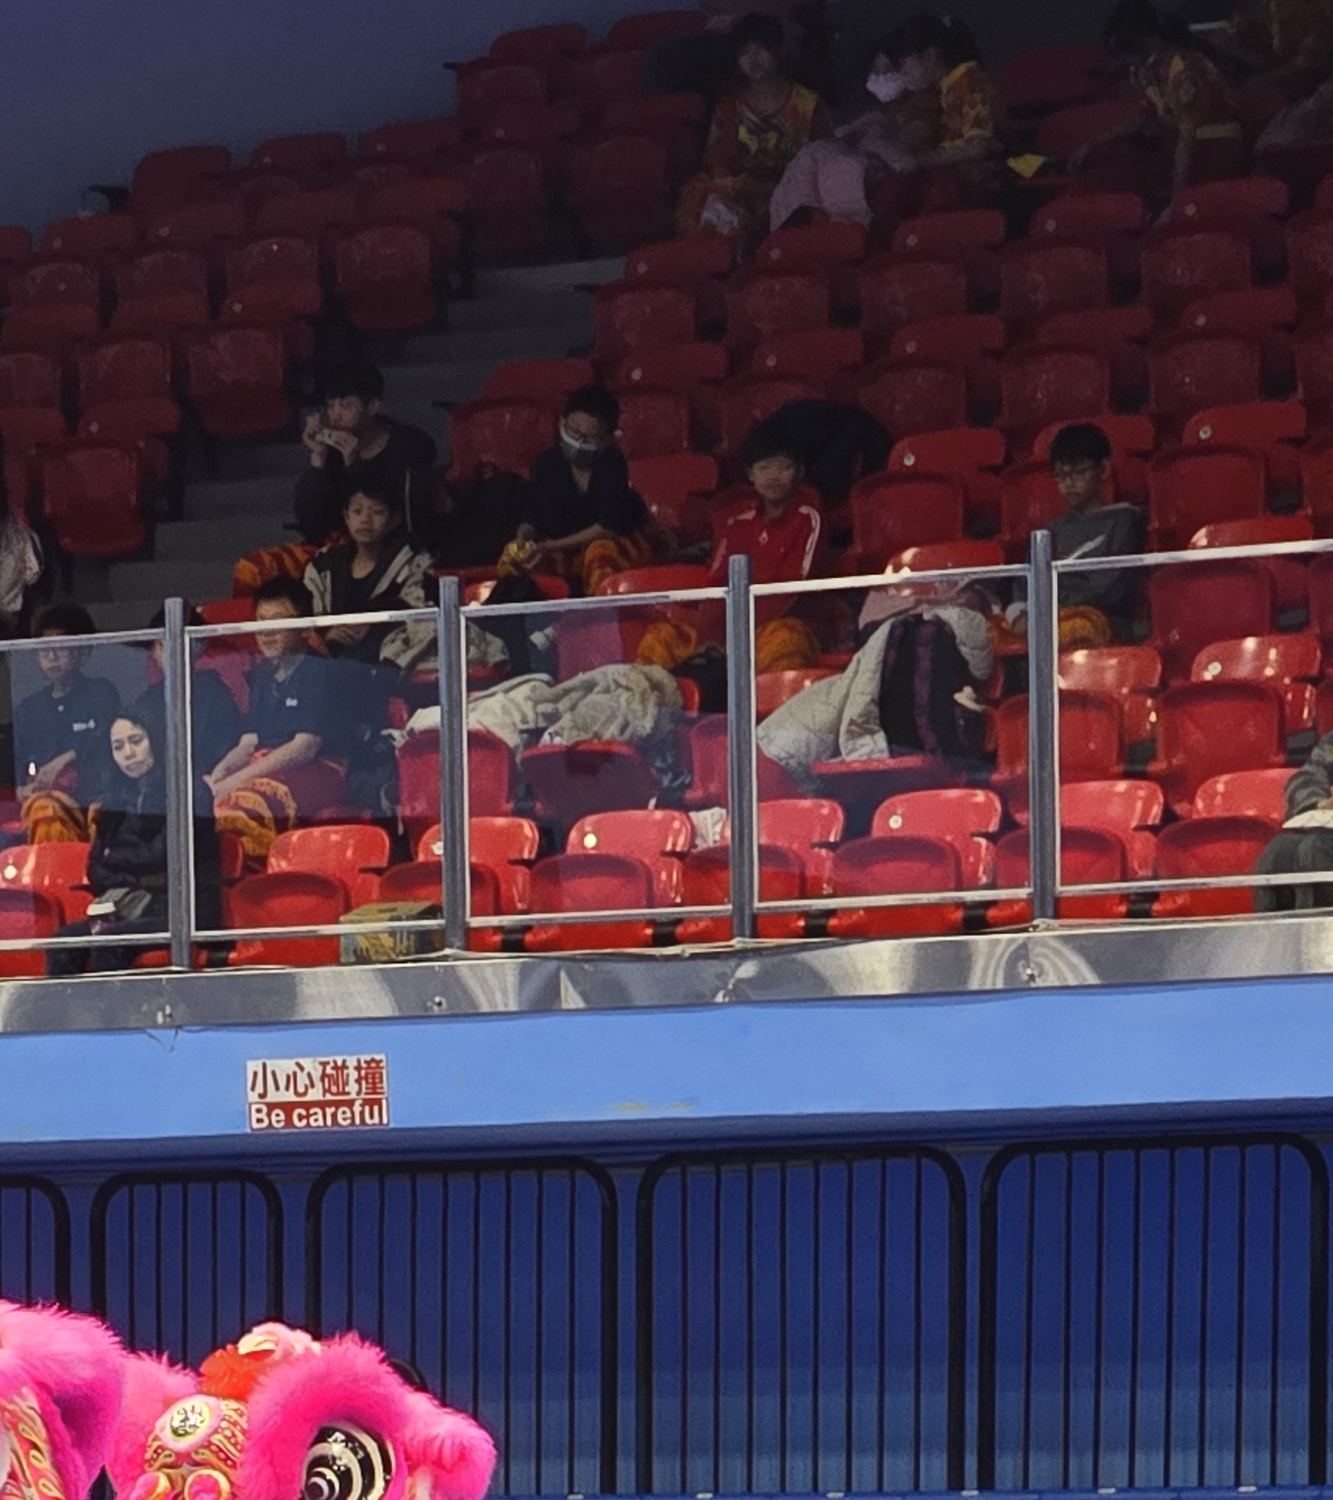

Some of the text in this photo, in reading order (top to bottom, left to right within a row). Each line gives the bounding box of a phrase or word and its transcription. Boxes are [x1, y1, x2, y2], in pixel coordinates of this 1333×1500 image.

[249, 1057, 386, 1100] 小心碰撞
[251, 1099, 388, 1129] Be careful
